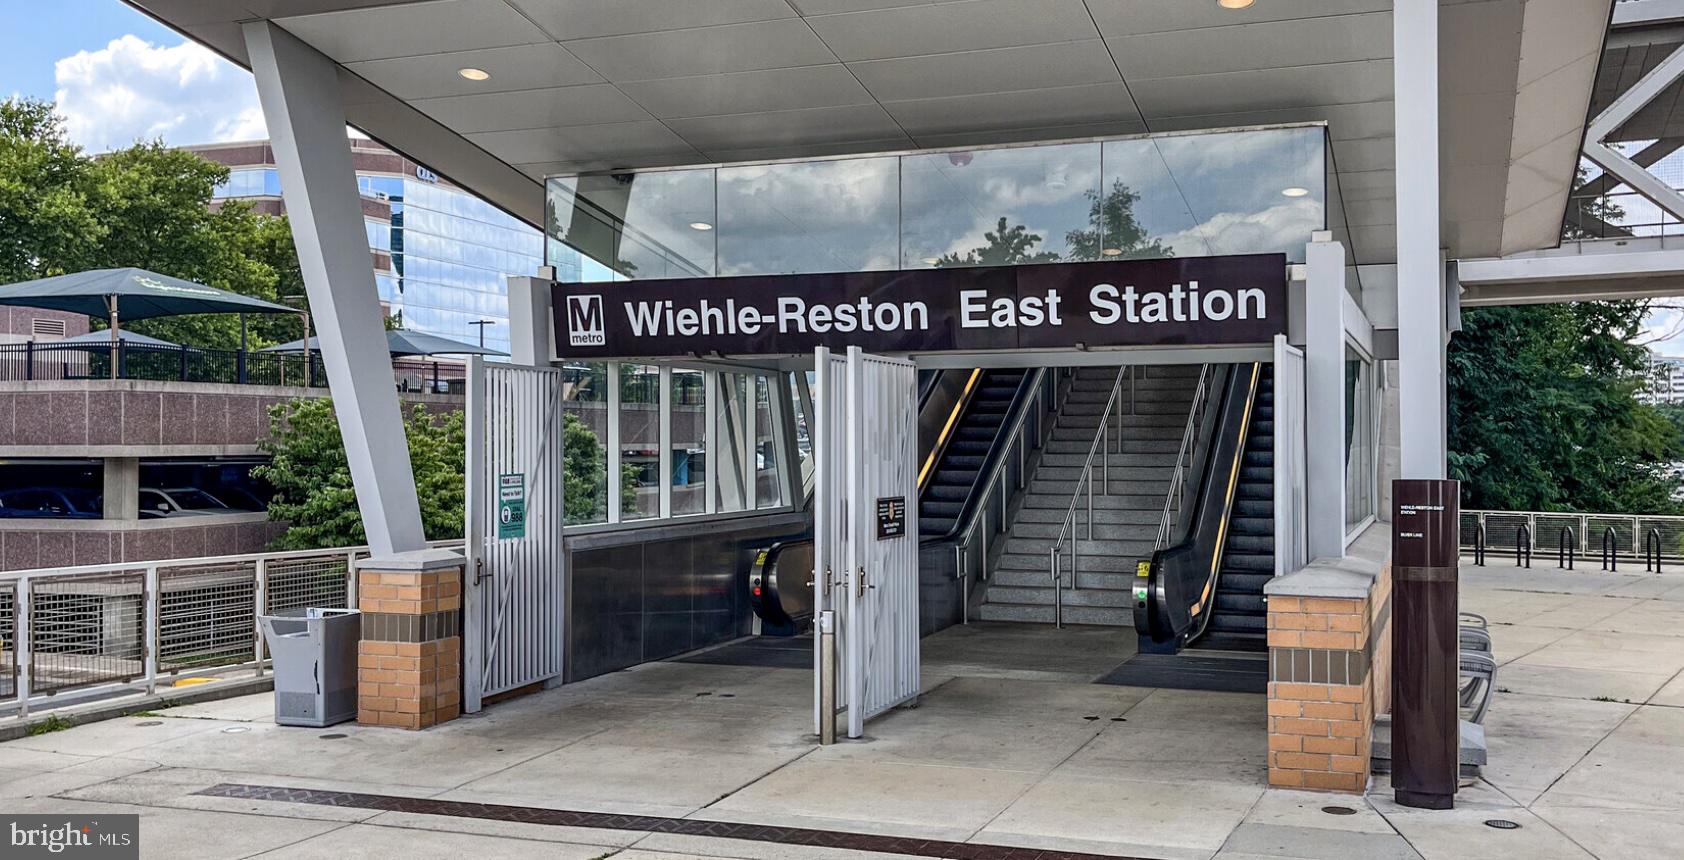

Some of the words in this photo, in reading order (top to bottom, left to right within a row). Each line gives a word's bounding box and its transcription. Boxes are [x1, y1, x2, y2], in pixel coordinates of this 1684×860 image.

[569, 297, 602, 331] M
[623, 296, 929, 337] Wiehle-Reston
[959, 289, 1062, 328] East
[1089, 280, 1266, 325] Station
[572, 334, 603, 343] metro
